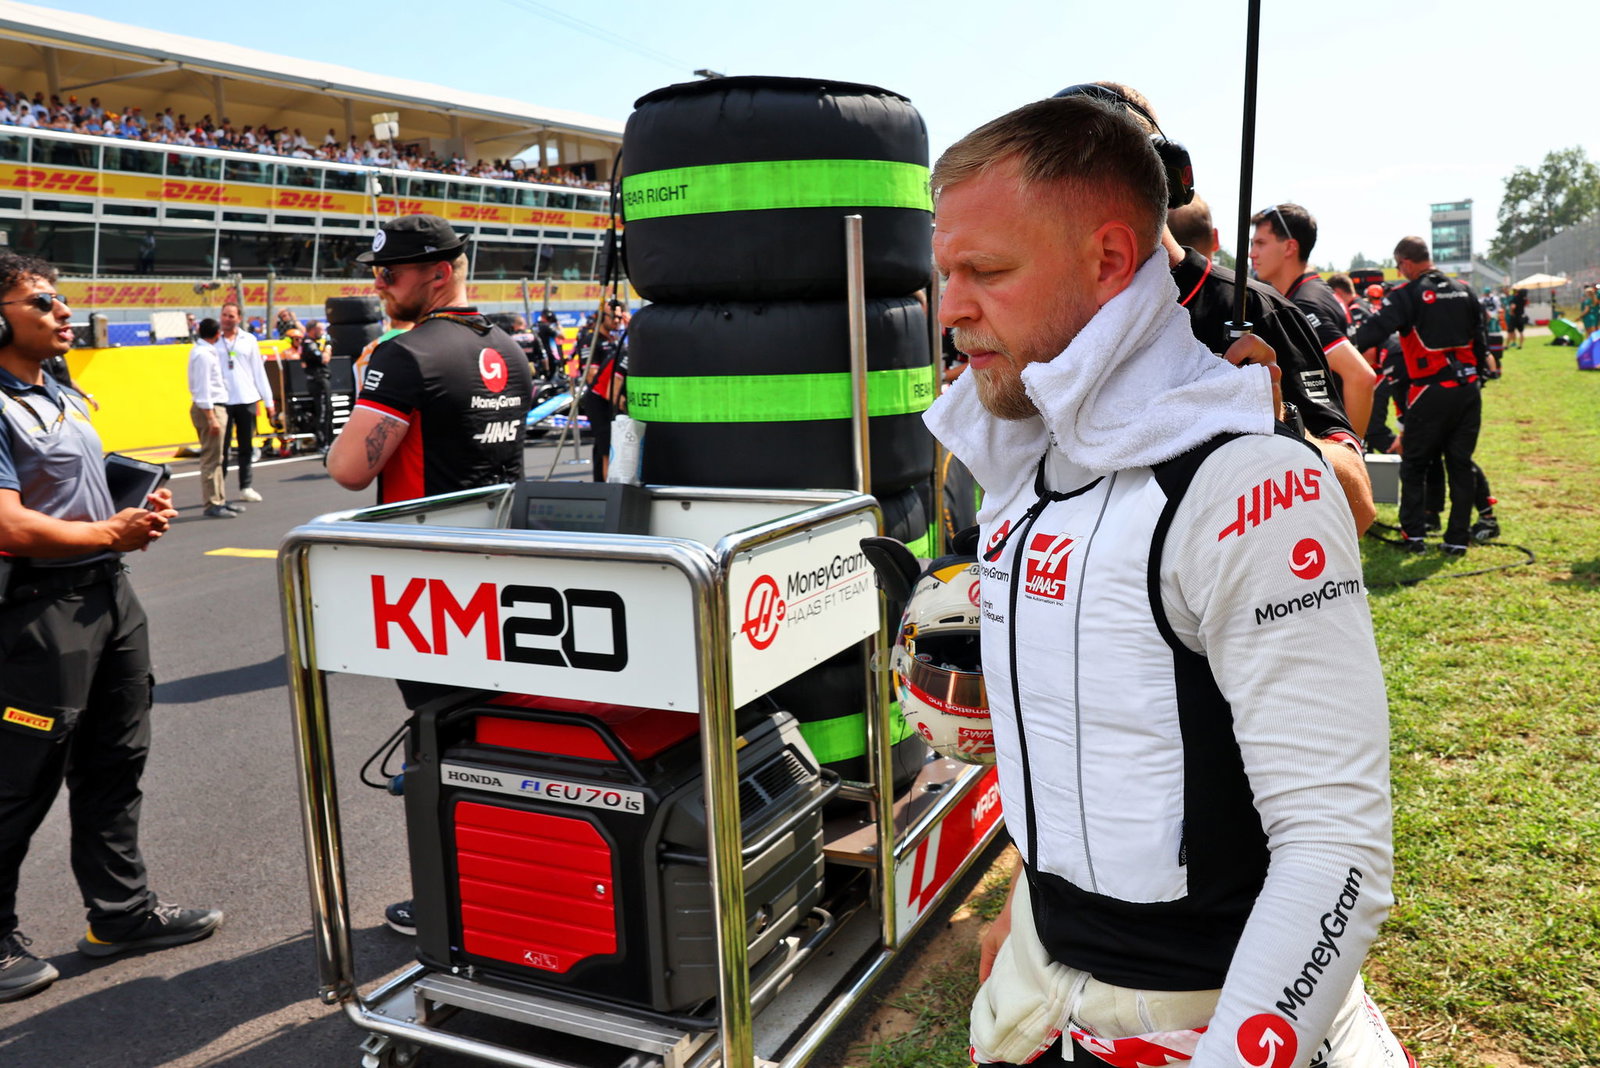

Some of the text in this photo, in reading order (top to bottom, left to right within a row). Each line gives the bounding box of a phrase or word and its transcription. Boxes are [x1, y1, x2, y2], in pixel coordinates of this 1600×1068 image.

[12, 169, 100, 192] DHL
[162, 182, 228, 203] DHL
[278, 191, 335, 210] DHL
[646, 184, 688, 203] RIGHT
[459, 206, 501, 221] DHL
[530, 211, 569, 226] DHL
[83, 286, 163, 304] DHL
[471, 395, 521, 410] MoneyGram
[637, 392, 660, 408] LEFT
[473, 419, 521, 444] HAAS
[1217, 468, 1322, 542] HAAS
[787, 552, 868, 600] MoneyGram
[1026, 575, 1066, 596] HAAS
[787, 578, 869, 628] HAAS F1 TEAM
[371, 574, 629, 672] KM20
[945, 703, 990, 715] omation
[448, 770, 503, 787] HONDA
[1275, 866, 1363, 1022] MoneyGram
